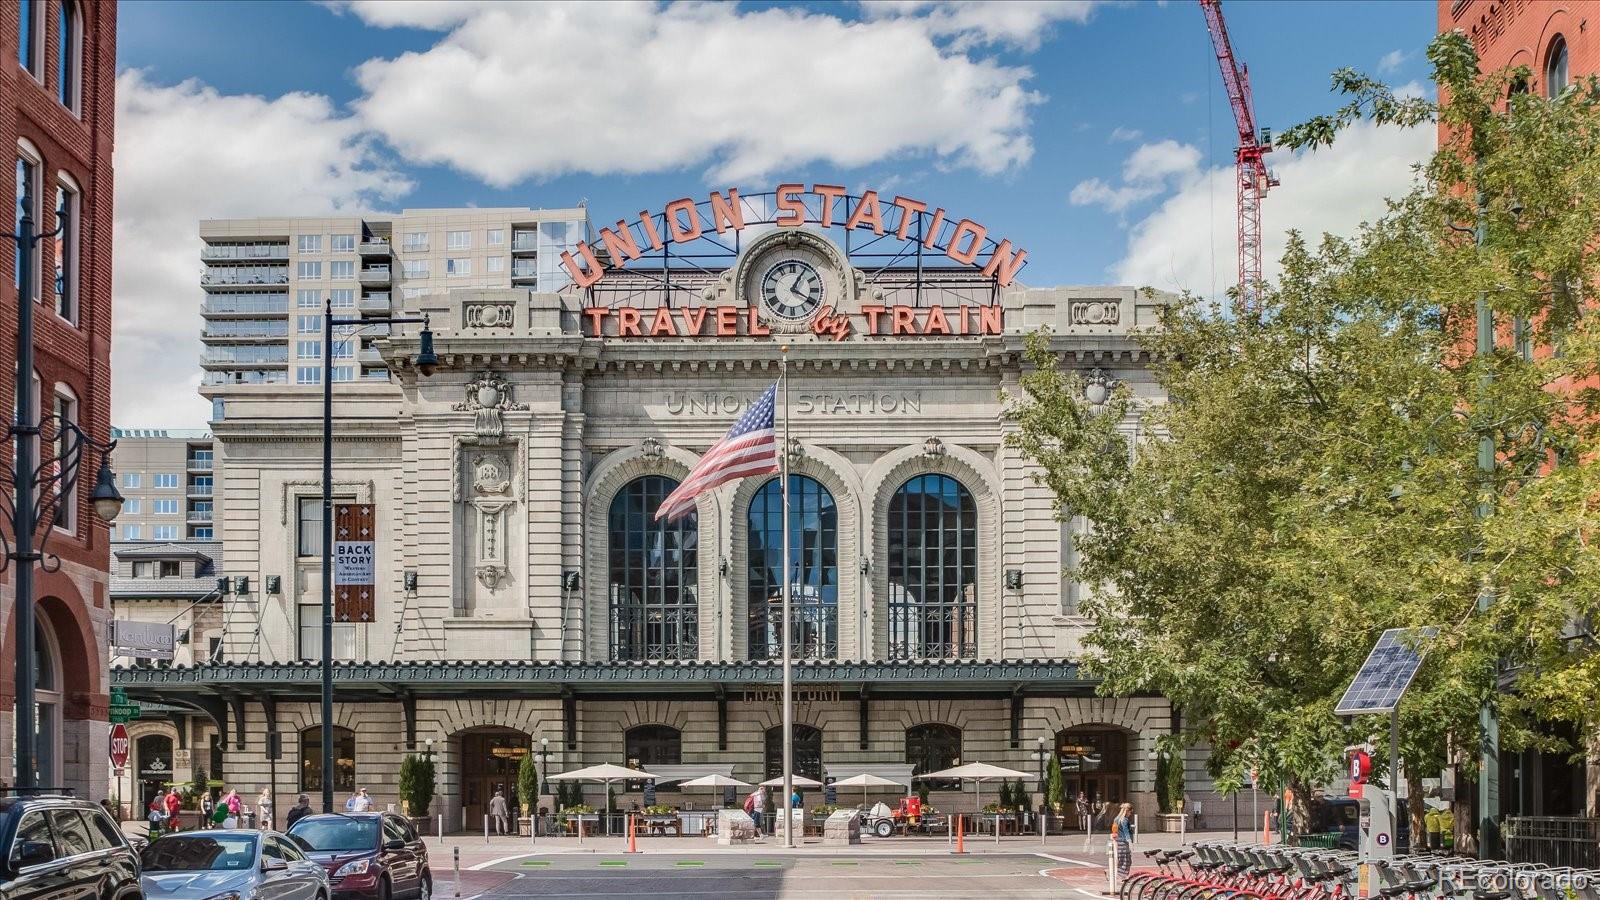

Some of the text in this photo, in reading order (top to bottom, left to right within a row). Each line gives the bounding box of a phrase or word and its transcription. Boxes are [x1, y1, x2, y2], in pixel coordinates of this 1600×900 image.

[560, 183, 1028, 288] UNION STATION
[584, 304, 1003, 341] TRAVEL by TRAIN
[796, 392, 922, 416] STATION
[338, 545, 371, 555] BACK
[338, 556, 371, 565] STORY
[112, 738, 128, 755] STOP
[1353, 759, 1360, 775] B
[1380, 834, 1387, 844] B
